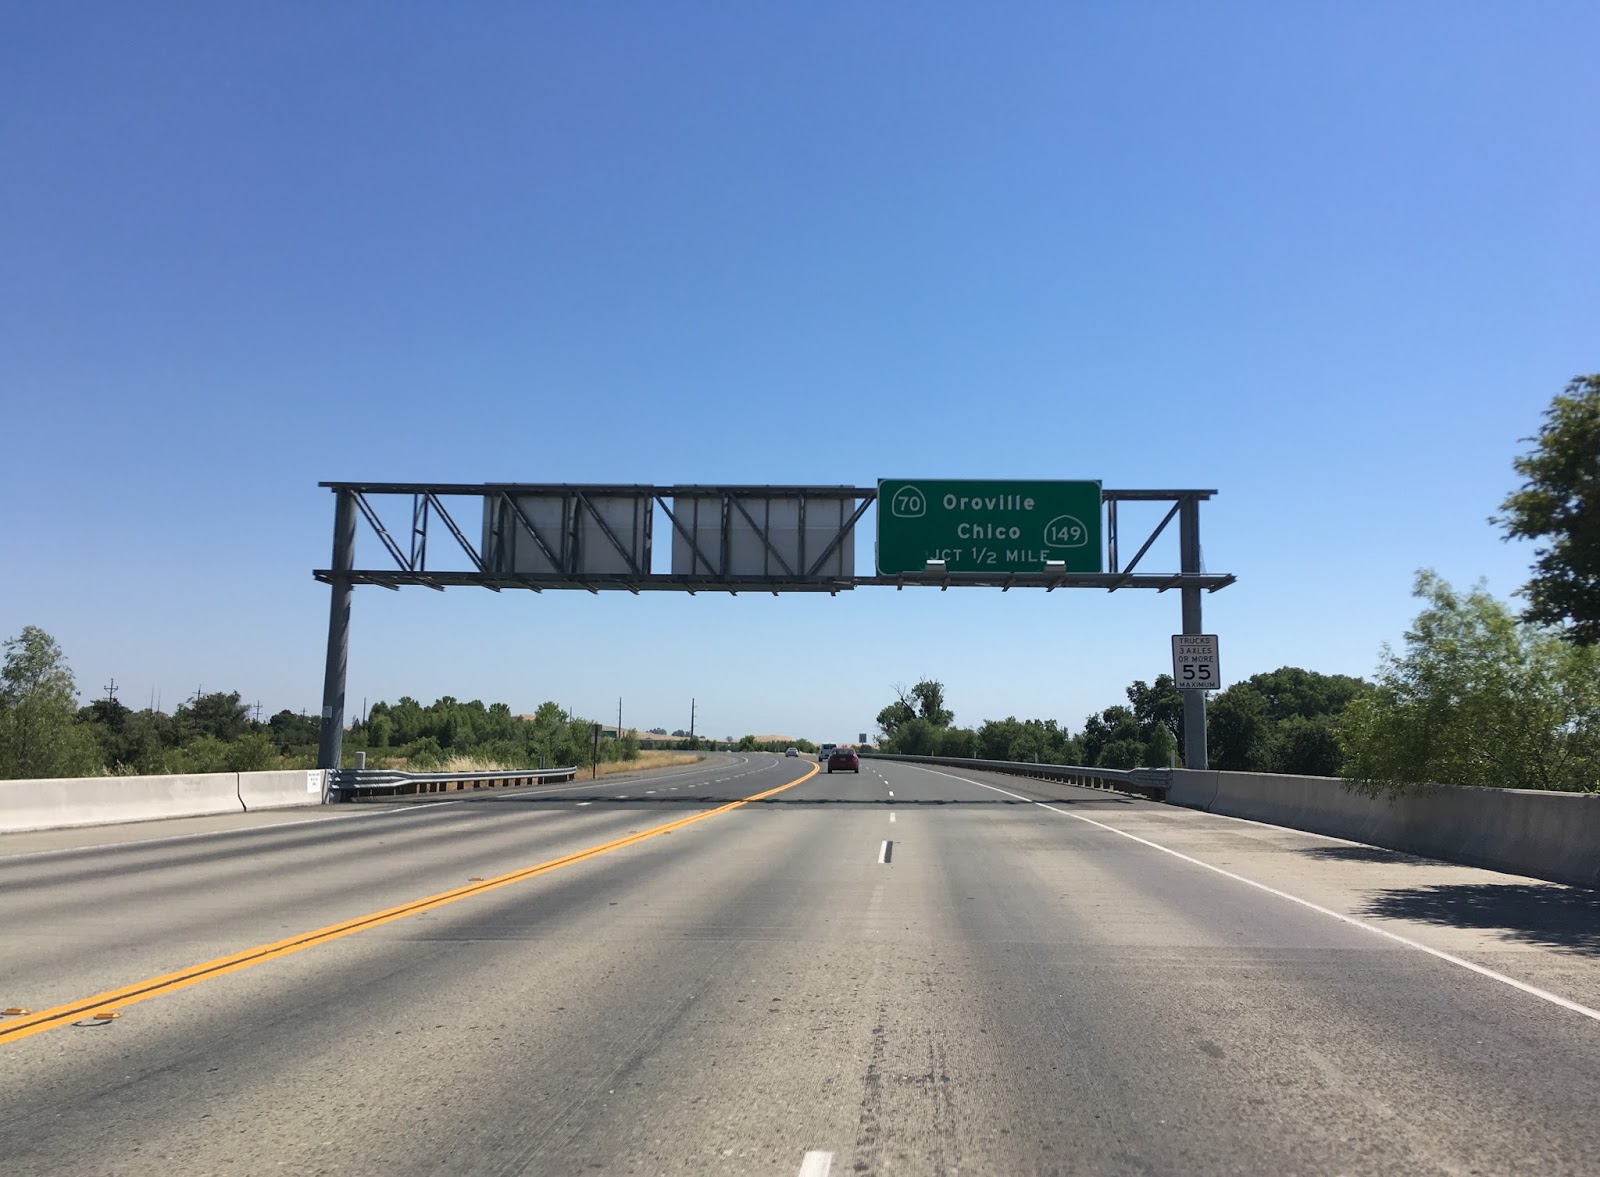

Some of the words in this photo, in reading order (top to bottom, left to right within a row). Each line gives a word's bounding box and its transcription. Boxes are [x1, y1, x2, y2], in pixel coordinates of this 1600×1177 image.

[898, 496, 920, 511] 70
[943, 494, 1036, 510] Oroville
[957, 523, 1021, 539] Chico
[1051, 526, 1082, 541] 149
[930, 549, 962, 561] JCT
[972, 547, 997, 564] 1/2
[1006, 549, 1050, 562] MILE
[1183, 665, 1211, 680] 55
